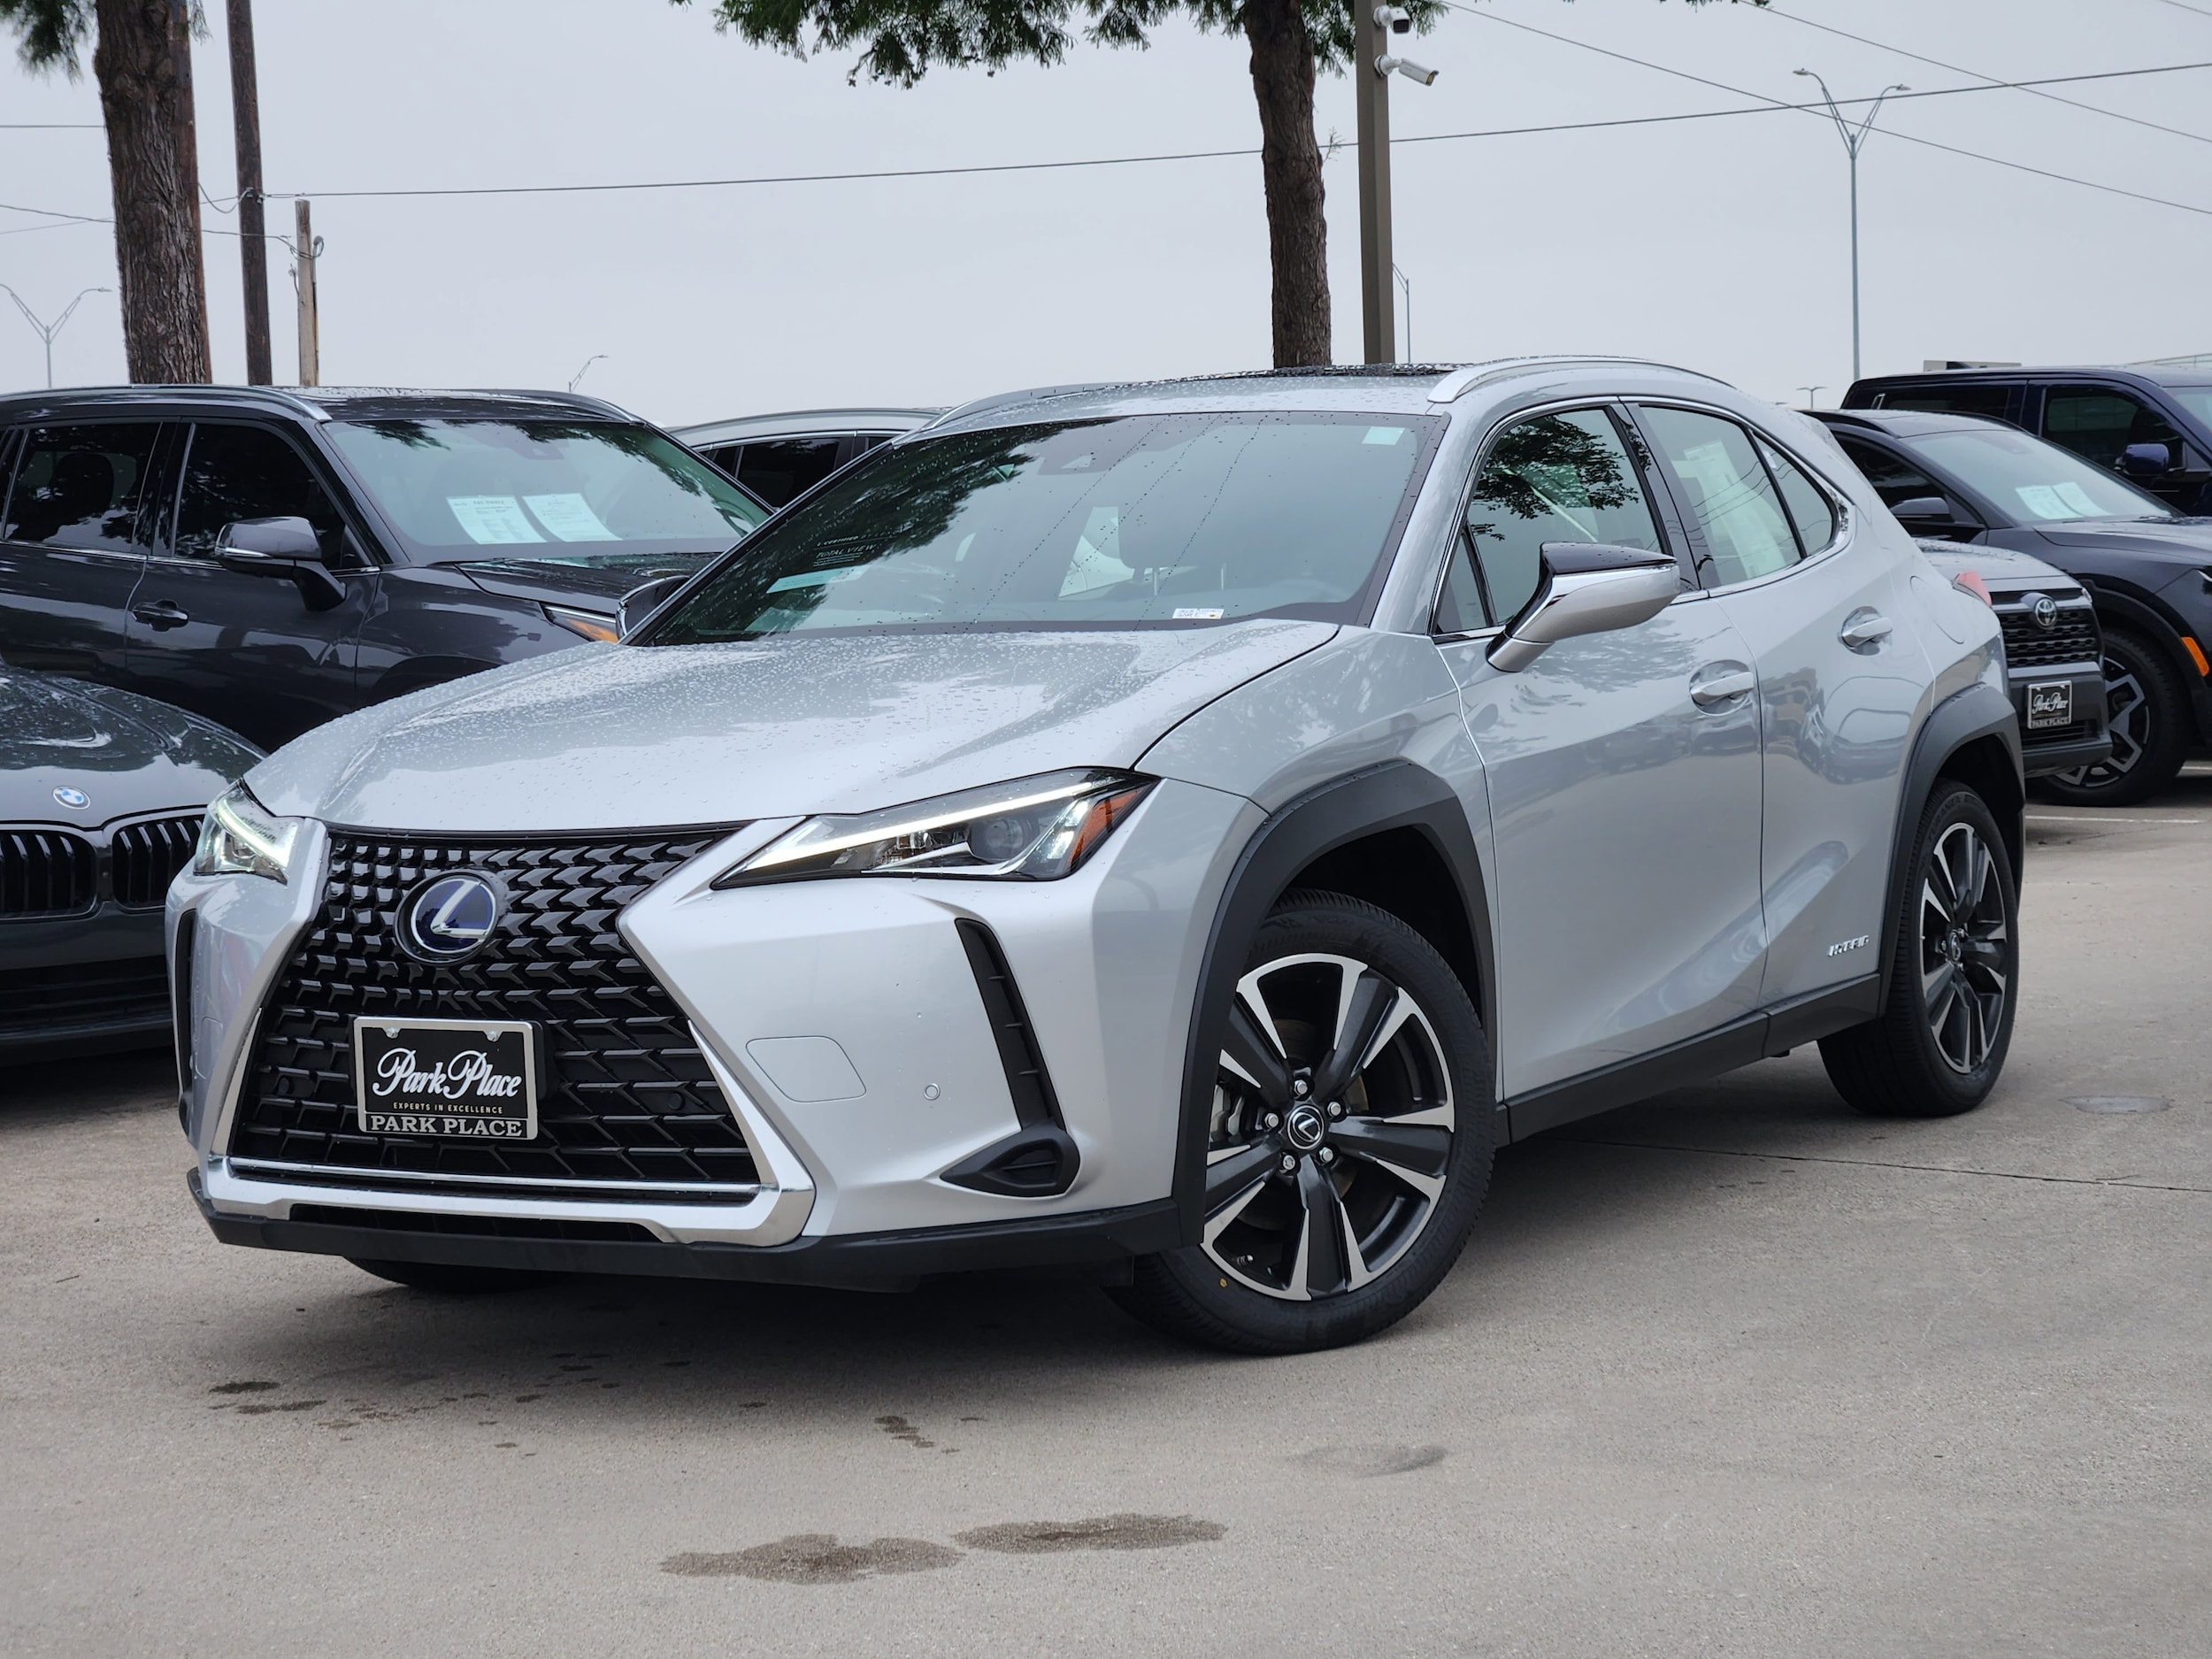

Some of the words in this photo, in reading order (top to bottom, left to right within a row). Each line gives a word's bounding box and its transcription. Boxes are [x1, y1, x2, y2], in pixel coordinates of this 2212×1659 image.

[816, 548, 844, 558] TOTAL
[848, 543, 878, 554] VIEW
[372, 1047, 446, 1096] Park
[442, 1049, 522, 1099] Place
[393, 1102, 431, 1111] EXPERTS
[448, 1104, 503, 1115] EXCELLENCE
[370, 1115, 437, 1133] PARK
[443, 1118, 523, 1137] PLACE
